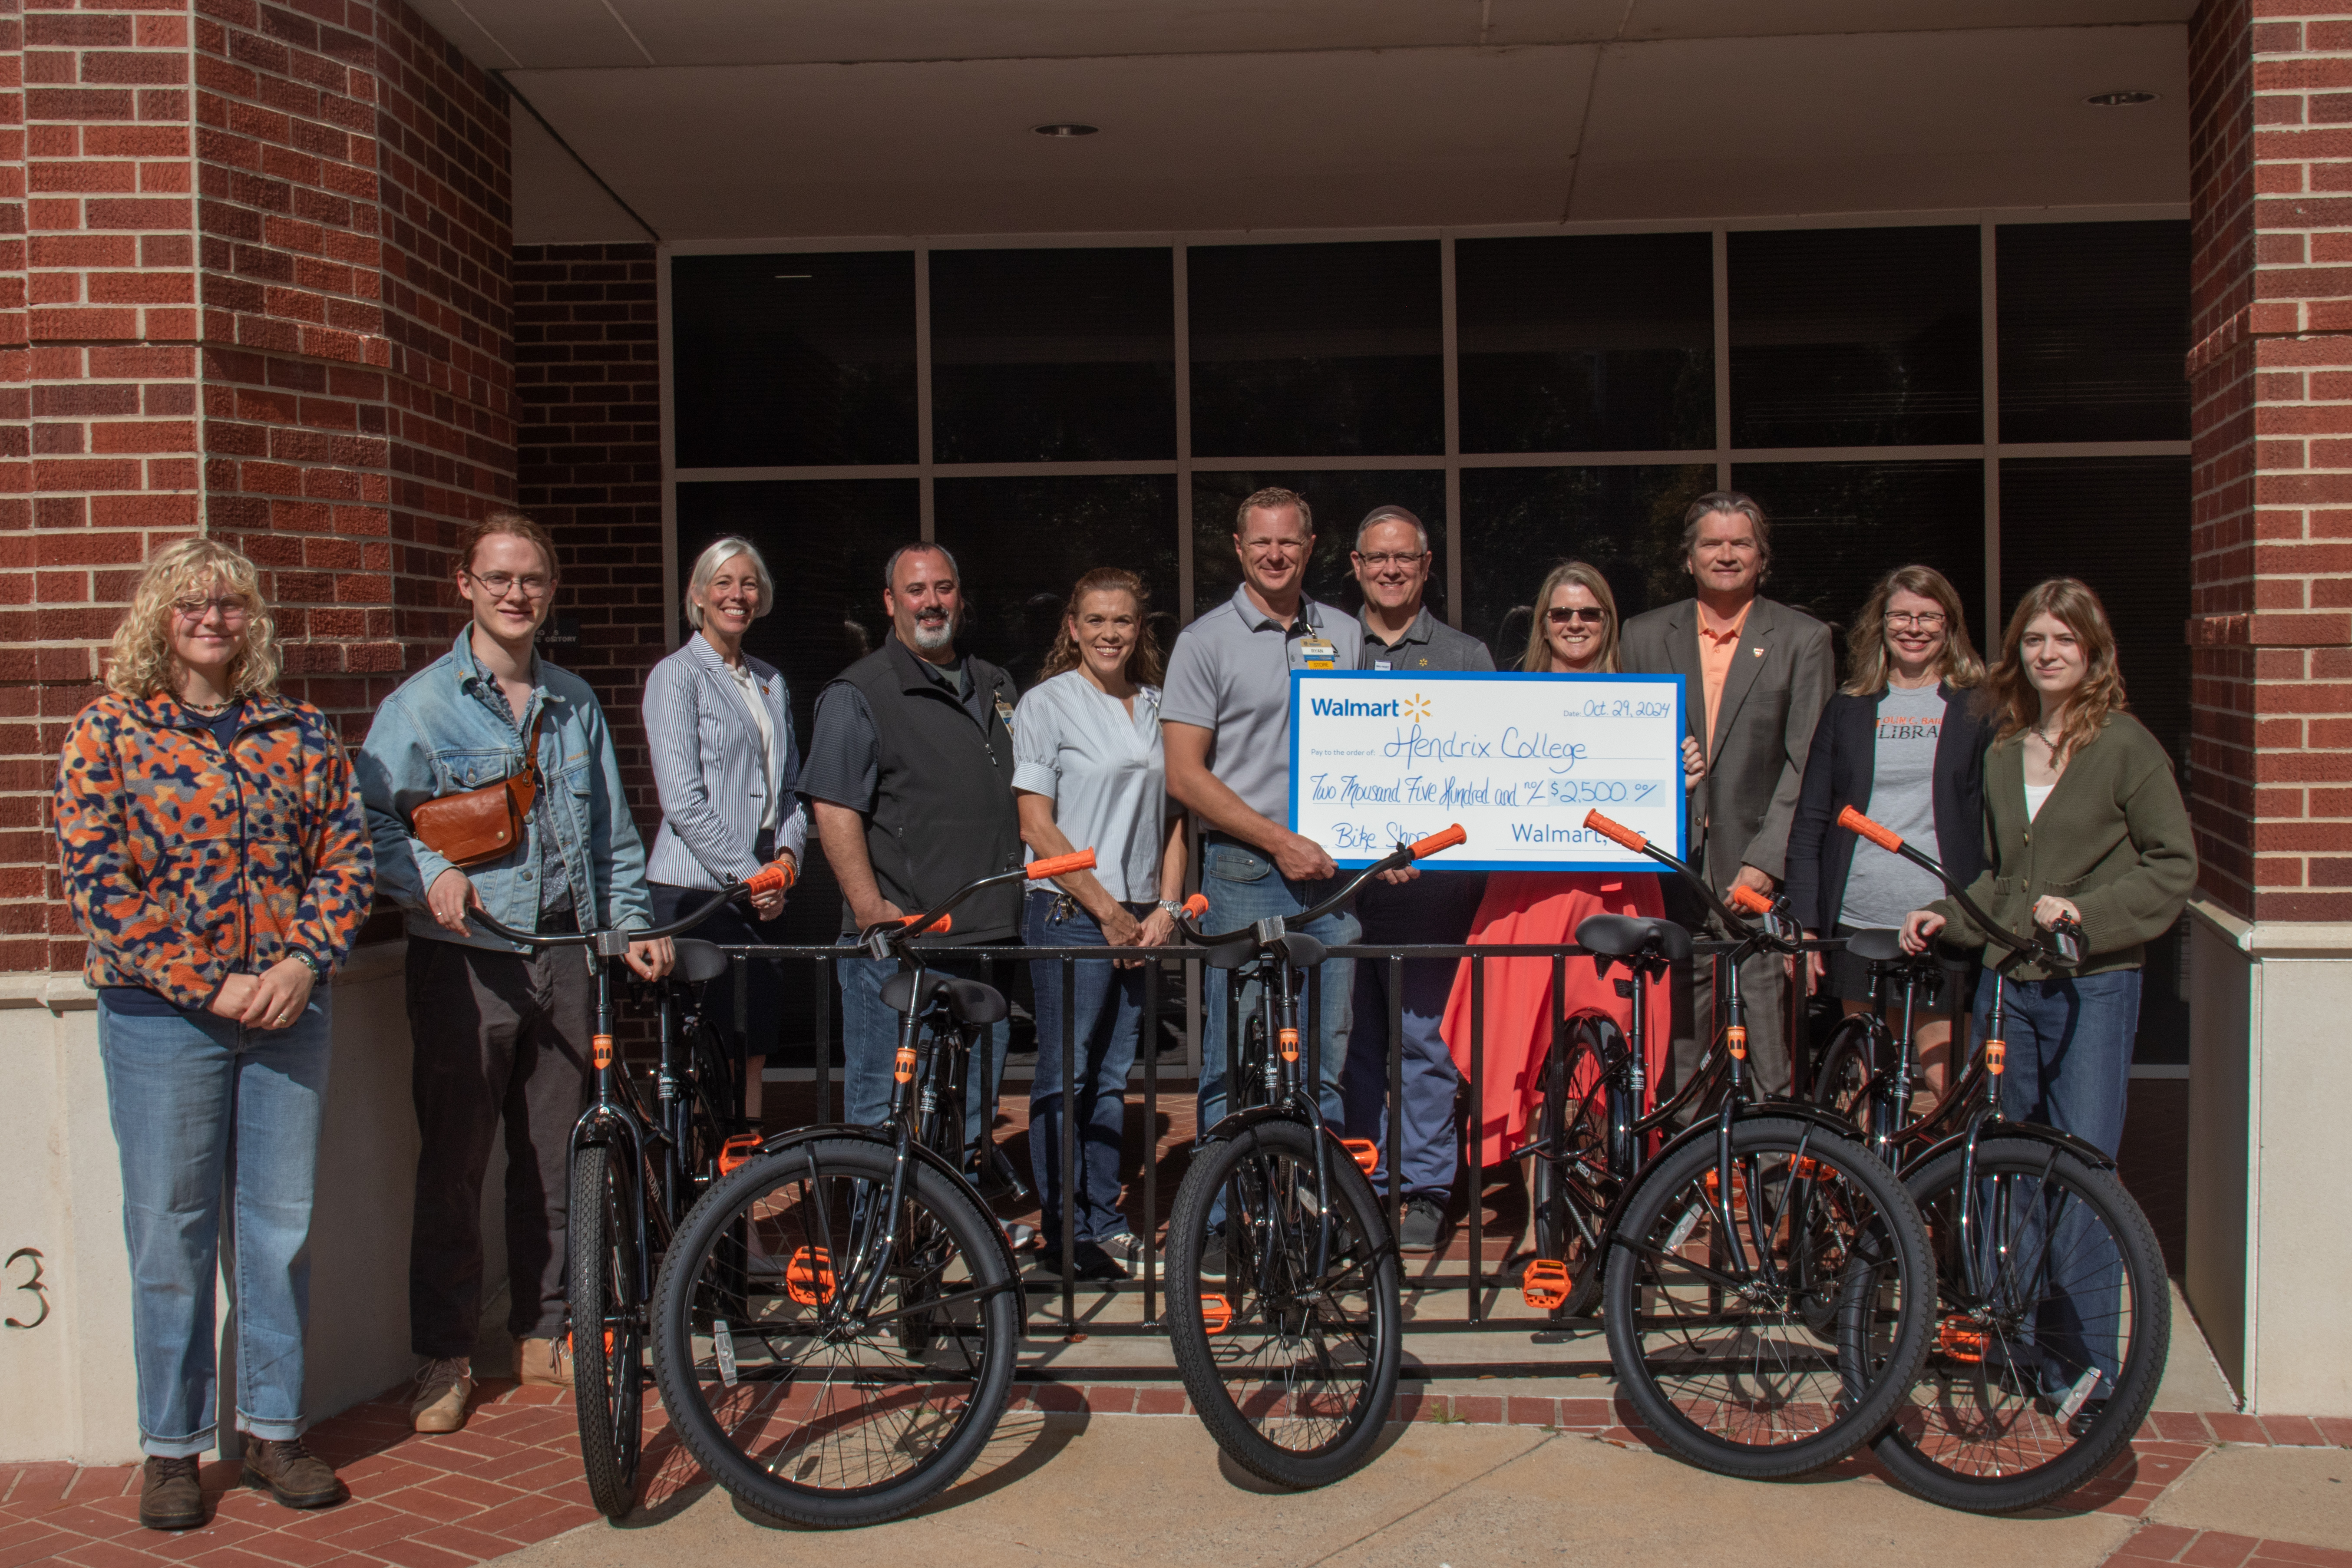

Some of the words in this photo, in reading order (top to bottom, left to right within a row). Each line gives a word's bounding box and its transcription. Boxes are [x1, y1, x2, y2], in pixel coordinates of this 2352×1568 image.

[1311, 698, 1399, 716] Walmart
[1583, 700, 1608, 716] Oct.
[1612, 700, 1632, 718] 29,
[1635, 701, 1670, 718] 2024
[1883, 716, 1906, 725] OLIN
[1877, 724, 1939, 739] LIBRA
[1311, 749, 1323, 757] Pay
[1384, 724, 1491, 770] Hendrix
[1501, 726, 1588, 774] College
[1310, 773, 1337, 800] Two
[1341, 775, 1400, 809] Thousand
[1405, 776, 1437, 803] Five
[1439, 776, 1490, 811] Hundred
[1495, 782, 1520, 807] and
[1331, 822, 1377, 853] Bike
[1575, 1160, 1591, 1178] REID
[4, 1247, 50, 1329] 3
